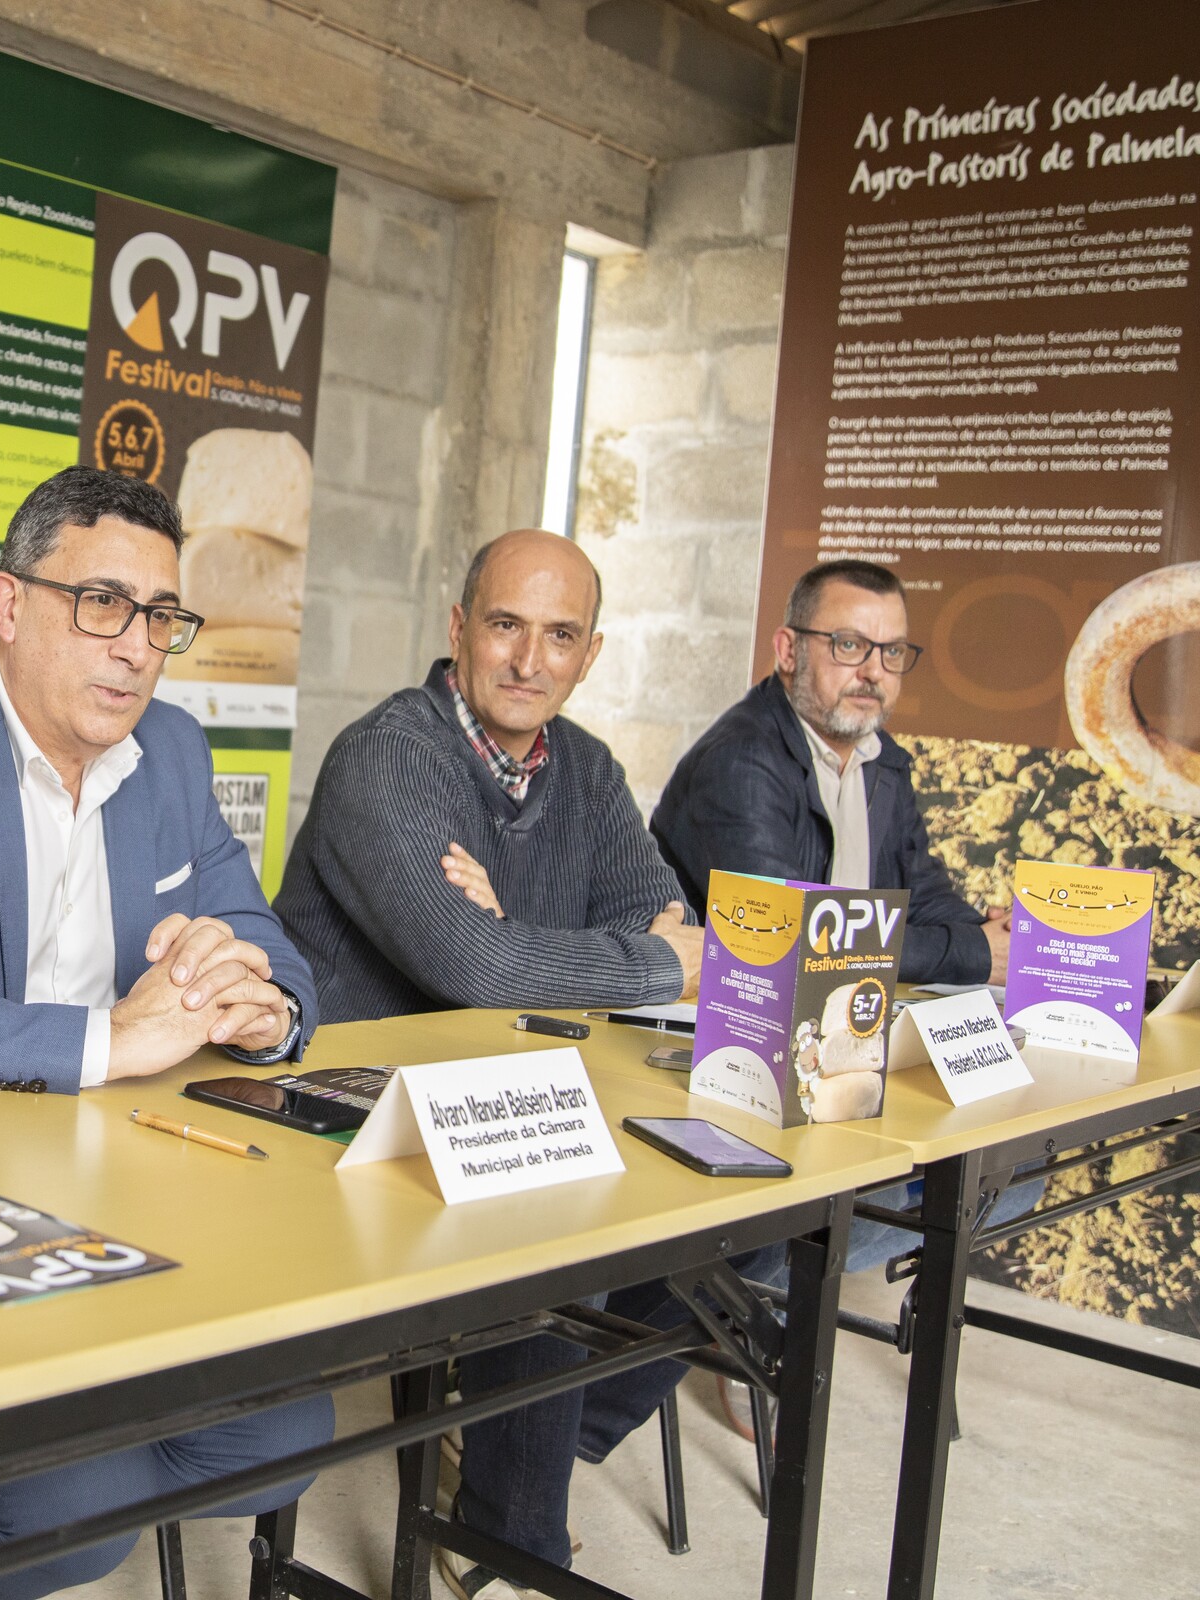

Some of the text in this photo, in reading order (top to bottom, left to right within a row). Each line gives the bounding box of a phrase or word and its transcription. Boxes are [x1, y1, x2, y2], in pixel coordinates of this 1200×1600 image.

[854, 74, 1200, 152] As Primeiras sociedades
[849, 125, 1200, 201] Agro-Pastoris de Palmela
[7, 195, 42, 217] Registo
[1088, 192, 1176, 214] documentada
[1179, 191, 1197, 205] na
[1070, 223, 1194, 248] Concelho de Palmela
[35, 253, 55, 270] bem
[110, 231, 310, 372] QPV
[44, 330, 72, 350] fronte
[1112, 341, 1181, 359] agricultura
[4, 348, 43, 367] chanfro
[44, 356, 69, 373] recto
[15, 374, 43, 392] fortes
[105, 349, 211, 399] Festival
[1099, 423, 1173, 441] conjunto de
[112, 450, 145, 469] Abril
[1101, 440, 1171, 456] económicos
[1120, 455, 1169, 471] Palmela
[215, 781, 266, 807] OSTAM
[808, 898, 902, 955] QPV
[804, 955, 848, 973] Festival
[853, 993, 882, 1014] 5-7
[928, 1015, 998, 1045] Francisco Macheta
[427, 1083, 587, 1130] Álvaro Manuel Balseiro Amaro
[448, 1118, 586, 1151] Presidente da Câmara
[461, 1142, 594, 1178] Municipal de Palmela
